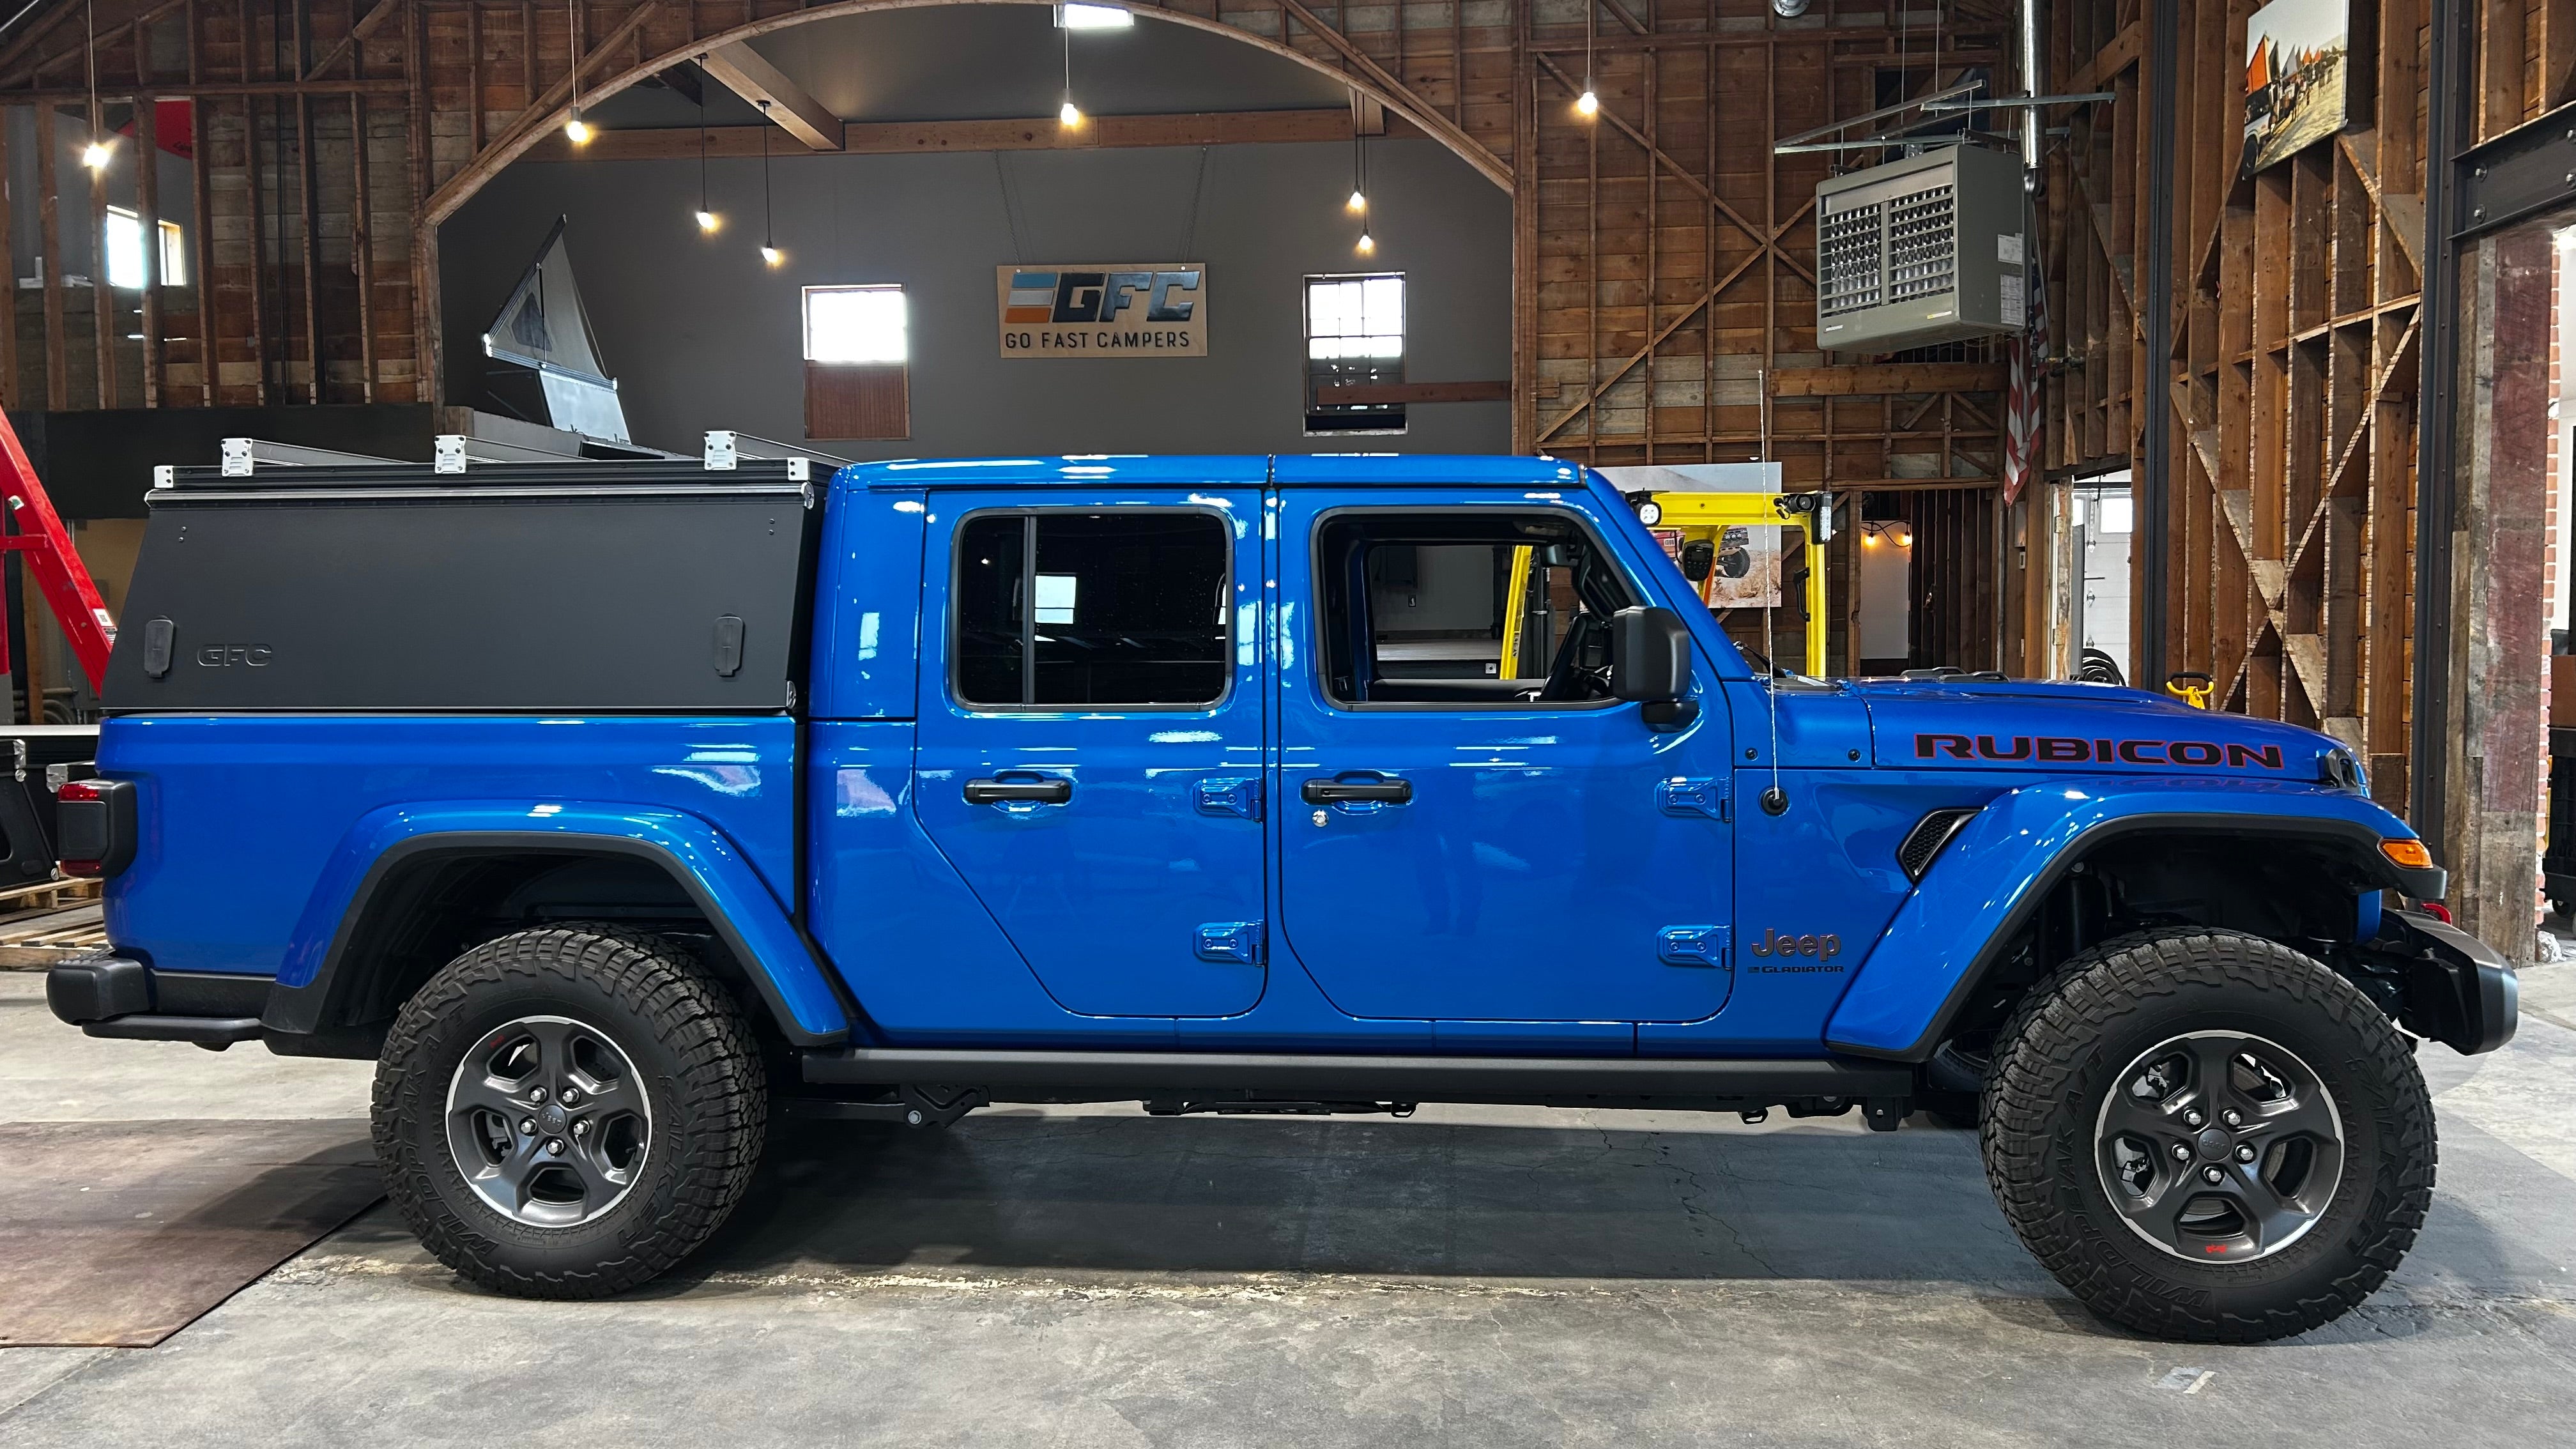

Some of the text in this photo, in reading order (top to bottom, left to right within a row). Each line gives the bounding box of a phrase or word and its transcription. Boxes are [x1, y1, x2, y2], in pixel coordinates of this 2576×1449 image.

[1052, 271, 1200, 322] GFC
[1005, 331, 1190, 348] GO FAST CAMPERS
[197, 643, 272, 666] GFC
[1915, 733, 2285, 769] RUBICON
[1751, 928, 1841, 962] Jeep
[1761, 965, 1845, 974] GLADIATOR
[401, 1060, 499, 1256] WILDPEAK
[2055, 1119, 2211, 1308] WILDPEAK
